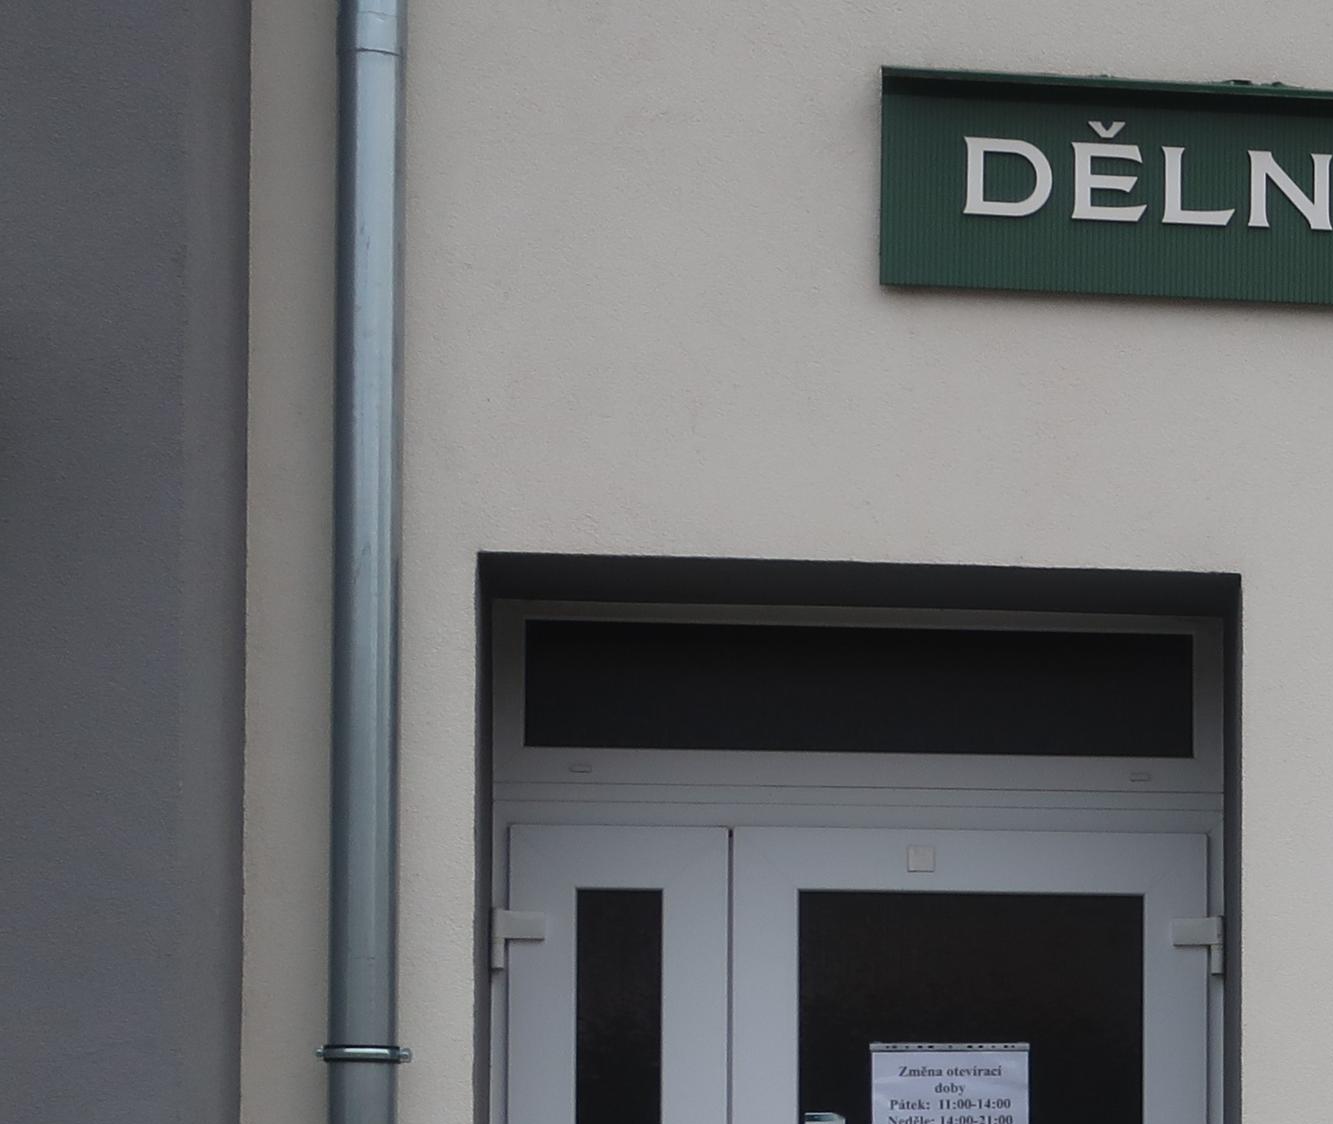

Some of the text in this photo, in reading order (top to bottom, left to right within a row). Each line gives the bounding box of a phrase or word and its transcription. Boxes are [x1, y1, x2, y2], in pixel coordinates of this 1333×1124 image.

[898, 1066, 943, 1077] Změna
[934, 1082, 966, 1095] doby
[890, 1098, 1012, 1110] Pátek: 11:00-14:00
